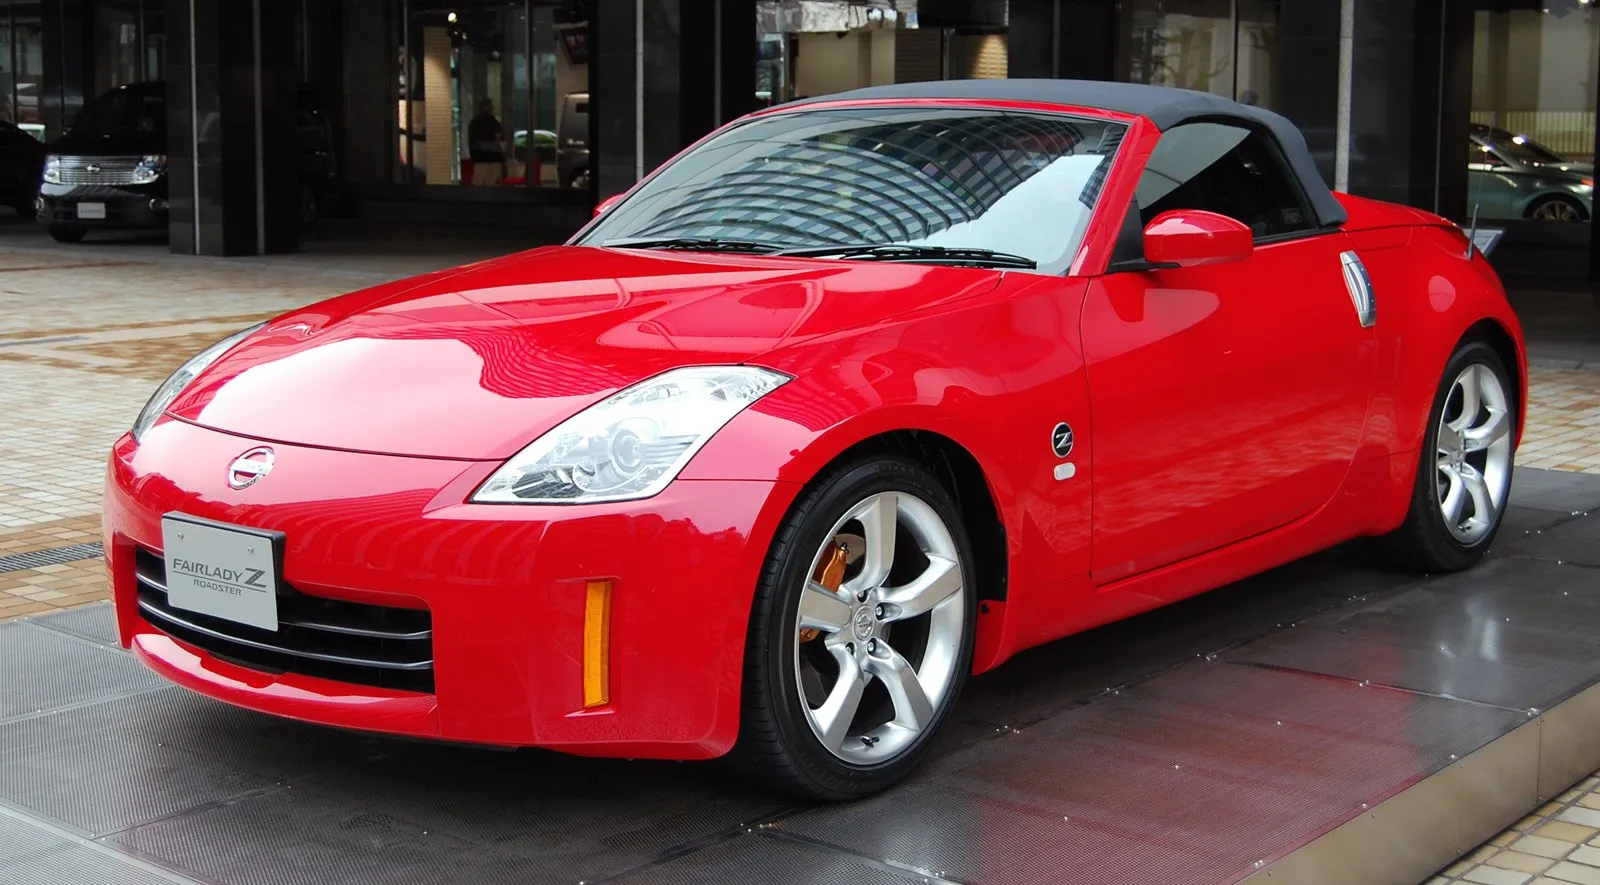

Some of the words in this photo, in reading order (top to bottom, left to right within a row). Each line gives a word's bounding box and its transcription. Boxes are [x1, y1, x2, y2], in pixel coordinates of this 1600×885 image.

[1056, 432, 1072, 449] Z
[173, 558, 243, 582] FAIRLADY
[244, 567, 267, 588] Z
[193, 579, 242, 596] ROADSTER
